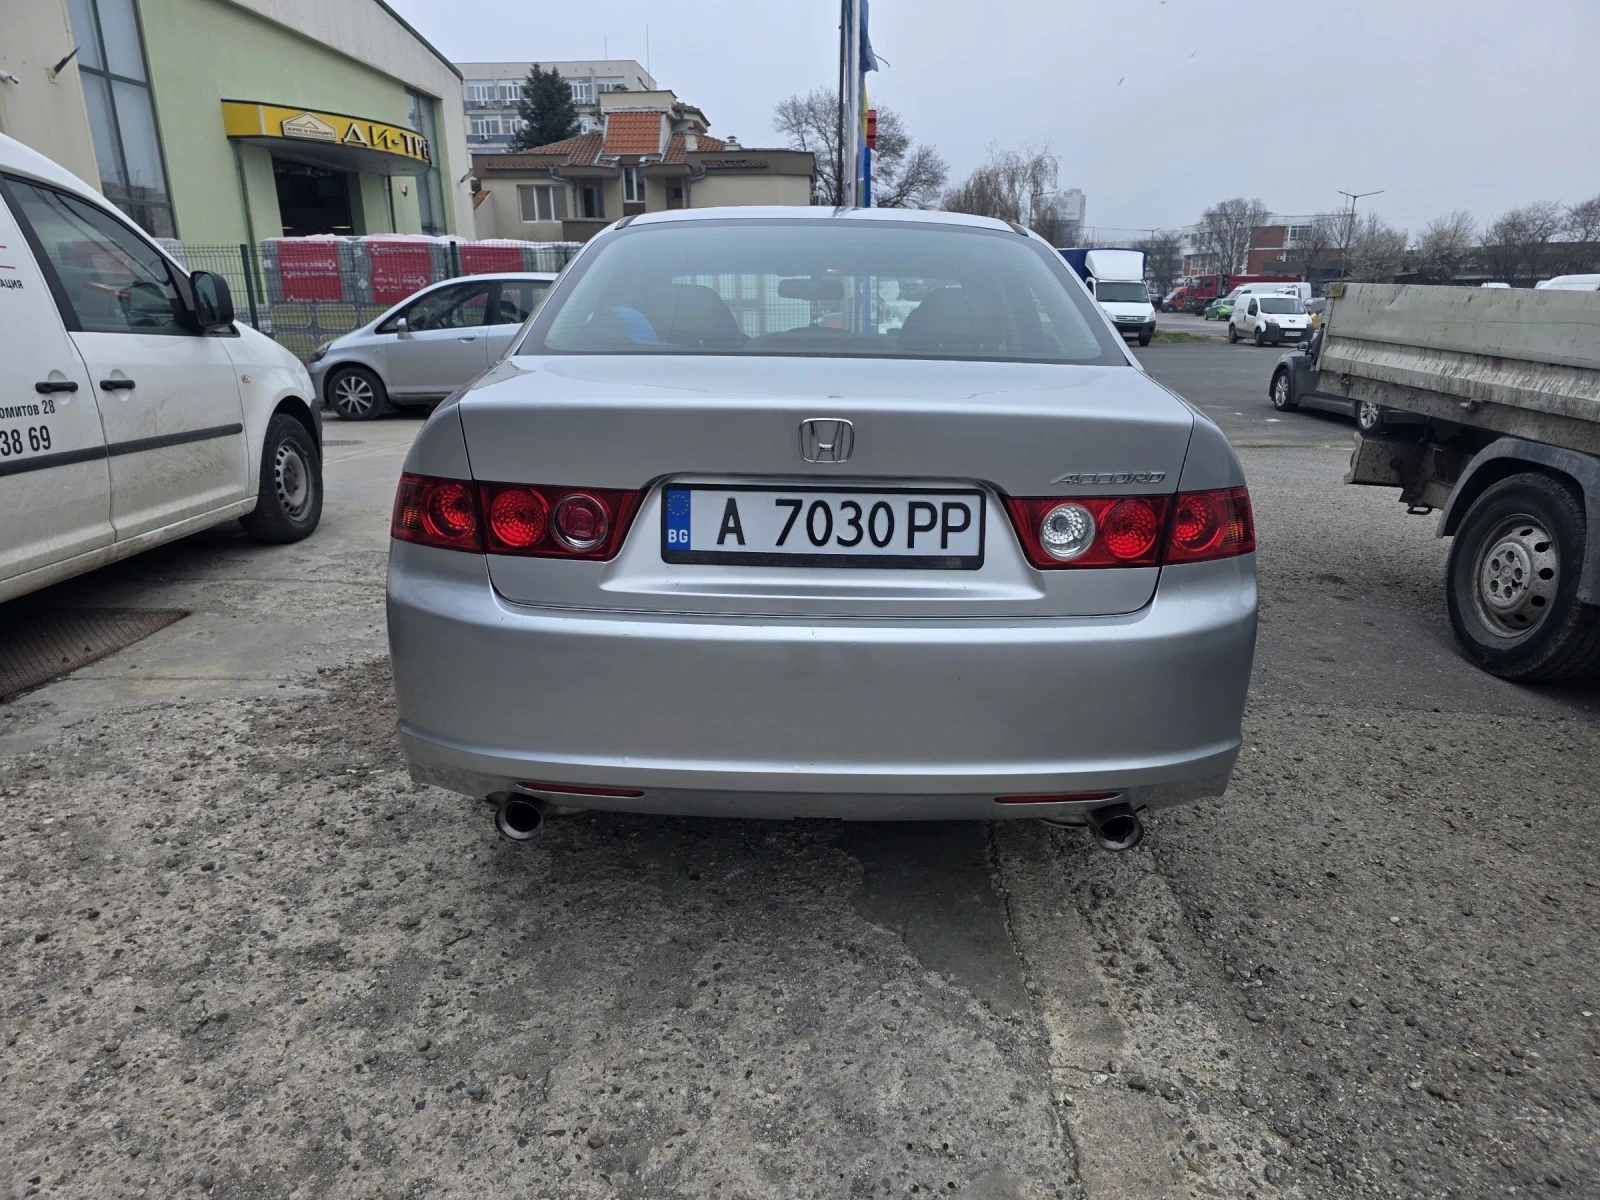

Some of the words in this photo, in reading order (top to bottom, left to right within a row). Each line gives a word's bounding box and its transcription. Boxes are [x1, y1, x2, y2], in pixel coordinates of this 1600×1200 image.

[0, 278, 24, 290] АЦИЯ
[41, 399, 55, 415] 28
[28, 425, 51, 452] 69
[1050, 471, 1165, 485] ACCORD
[716, 497, 746, 545] A
[775, 498, 895, 548] 7030
[907, 501, 971, 549] PP
[668, 529, 689, 543] BG
